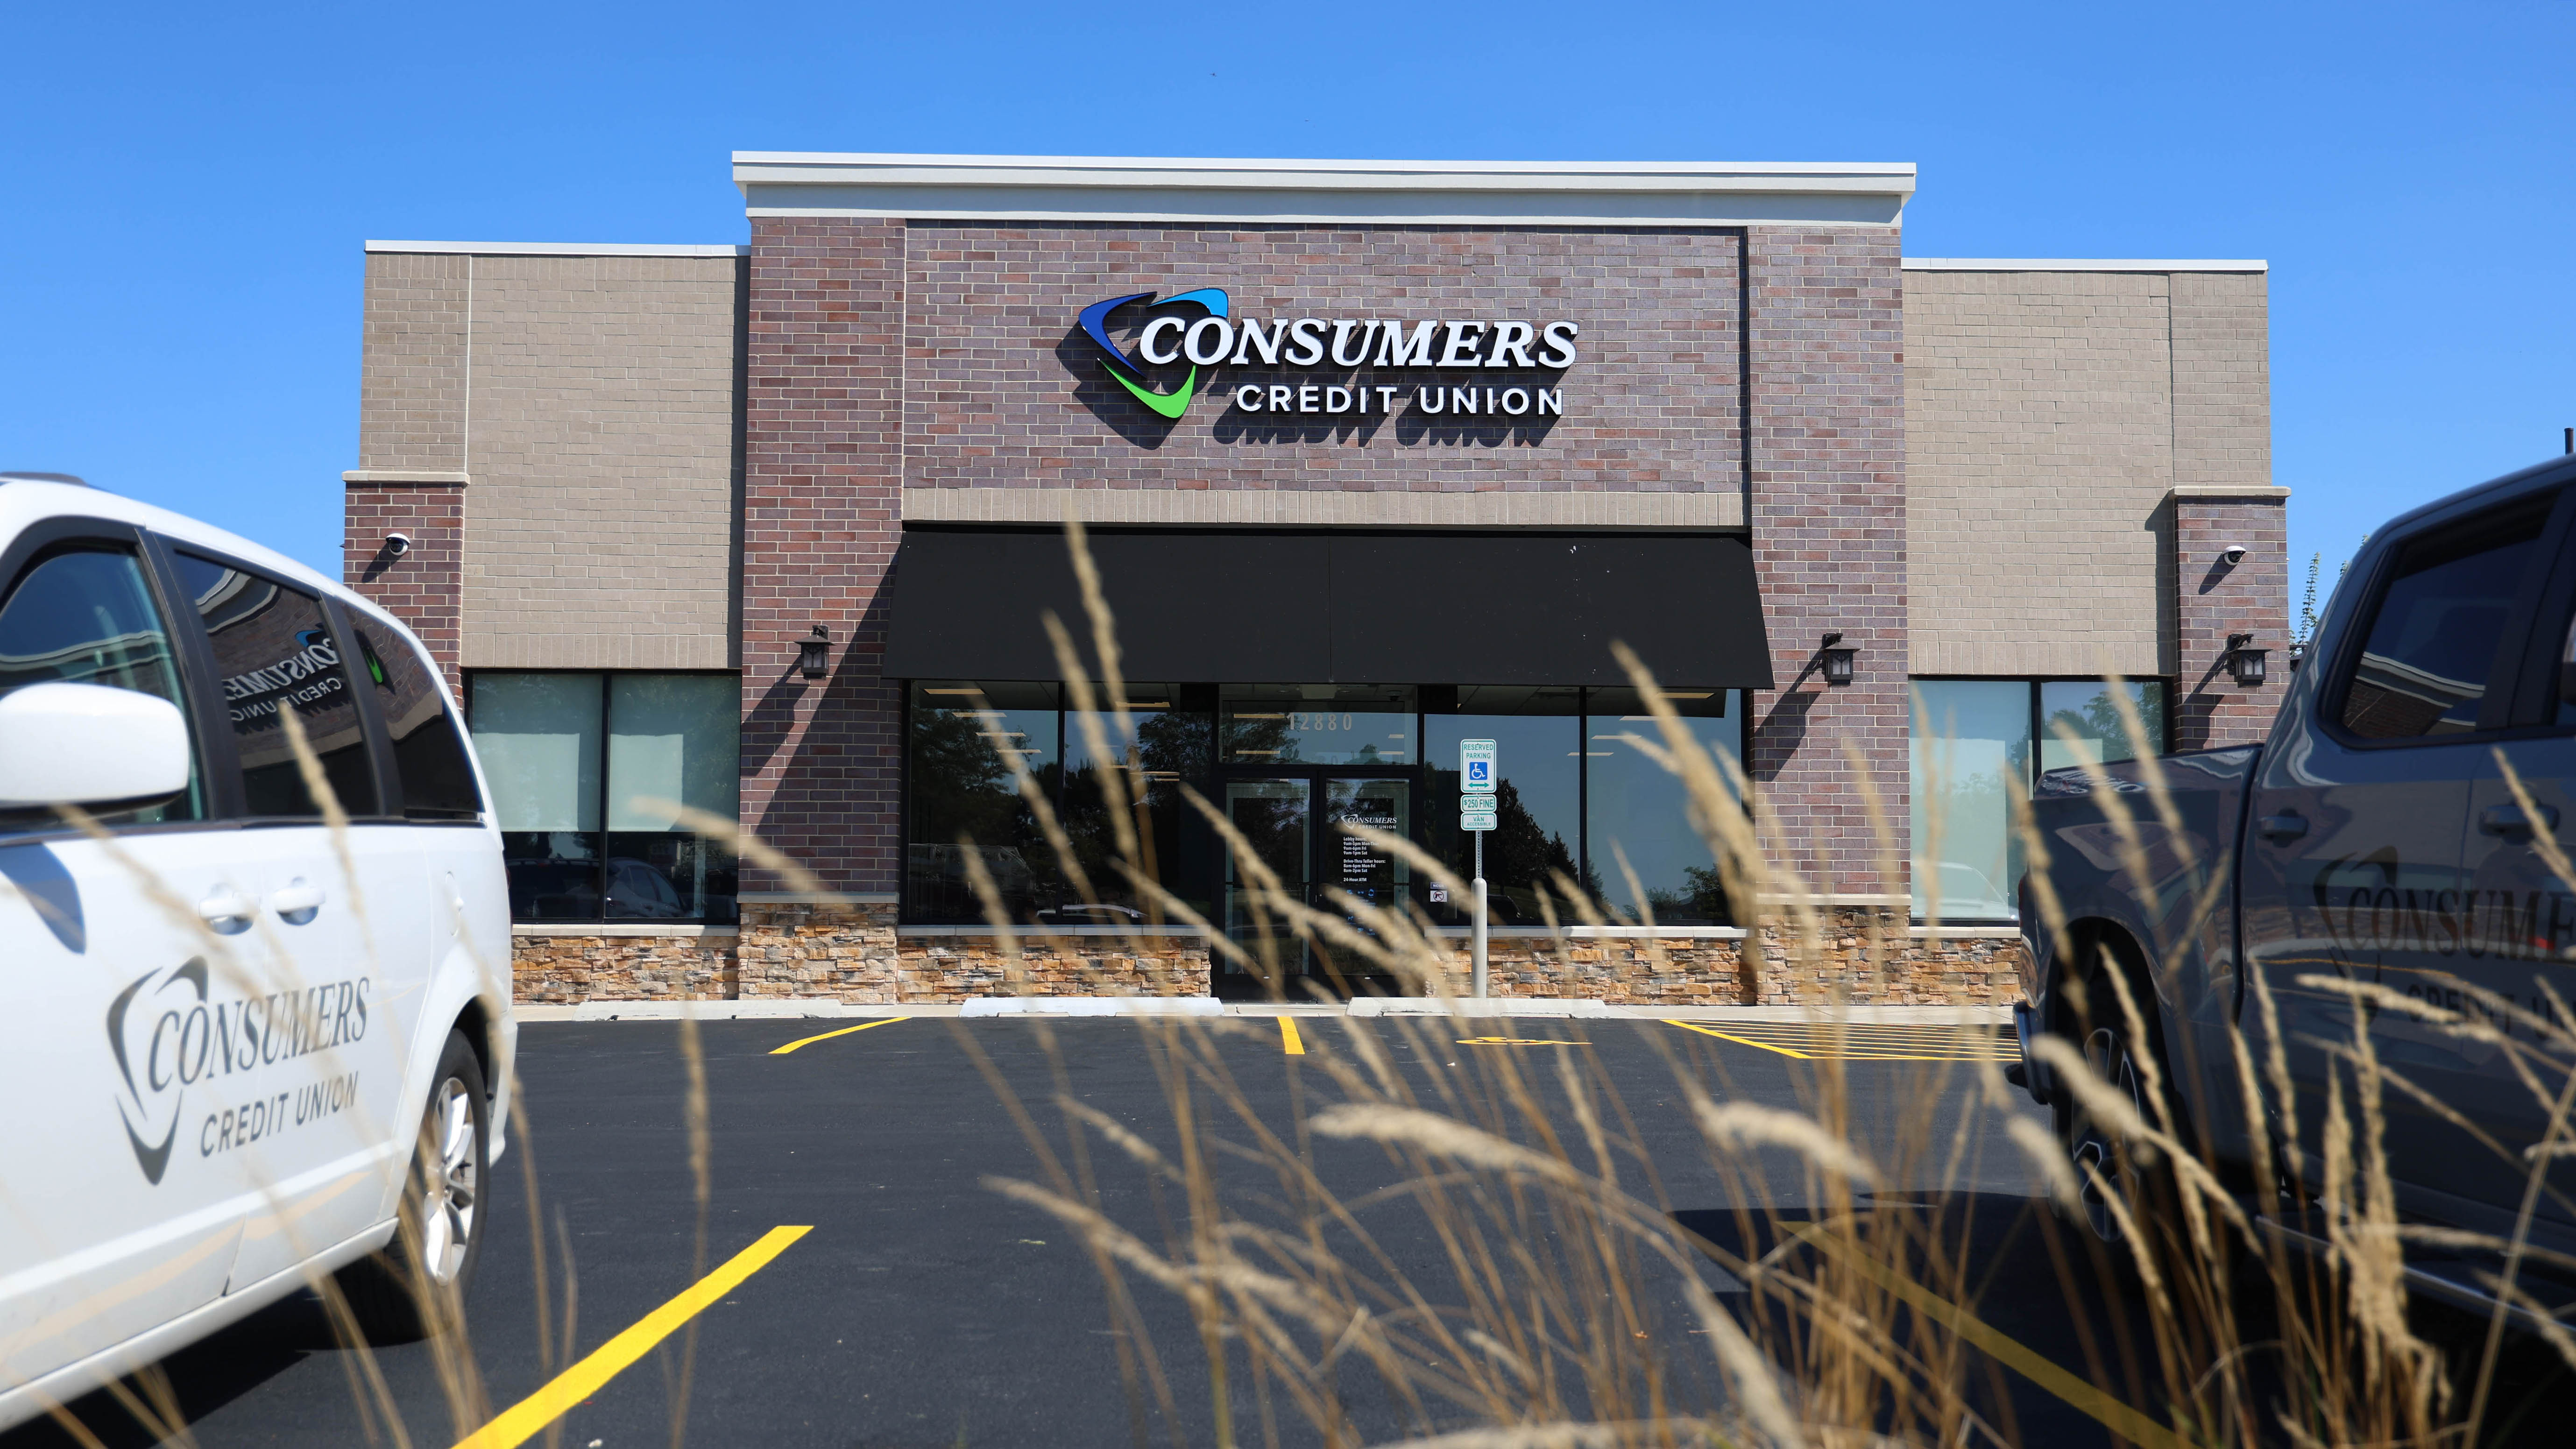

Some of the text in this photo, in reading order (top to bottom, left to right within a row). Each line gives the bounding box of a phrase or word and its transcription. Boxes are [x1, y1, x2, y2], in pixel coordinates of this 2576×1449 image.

[1139, 316, 1579, 368] CONSUMERS
[1236, 384, 1563, 416] CREDIT UNION
[1287, 713, 1352, 731] 12880
[1464, 799, 1494, 808] $250 FINE
[148, 976, 369, 1092] CONSUMERS
[199, 1071, 359, 1157] CREDIT UNION
